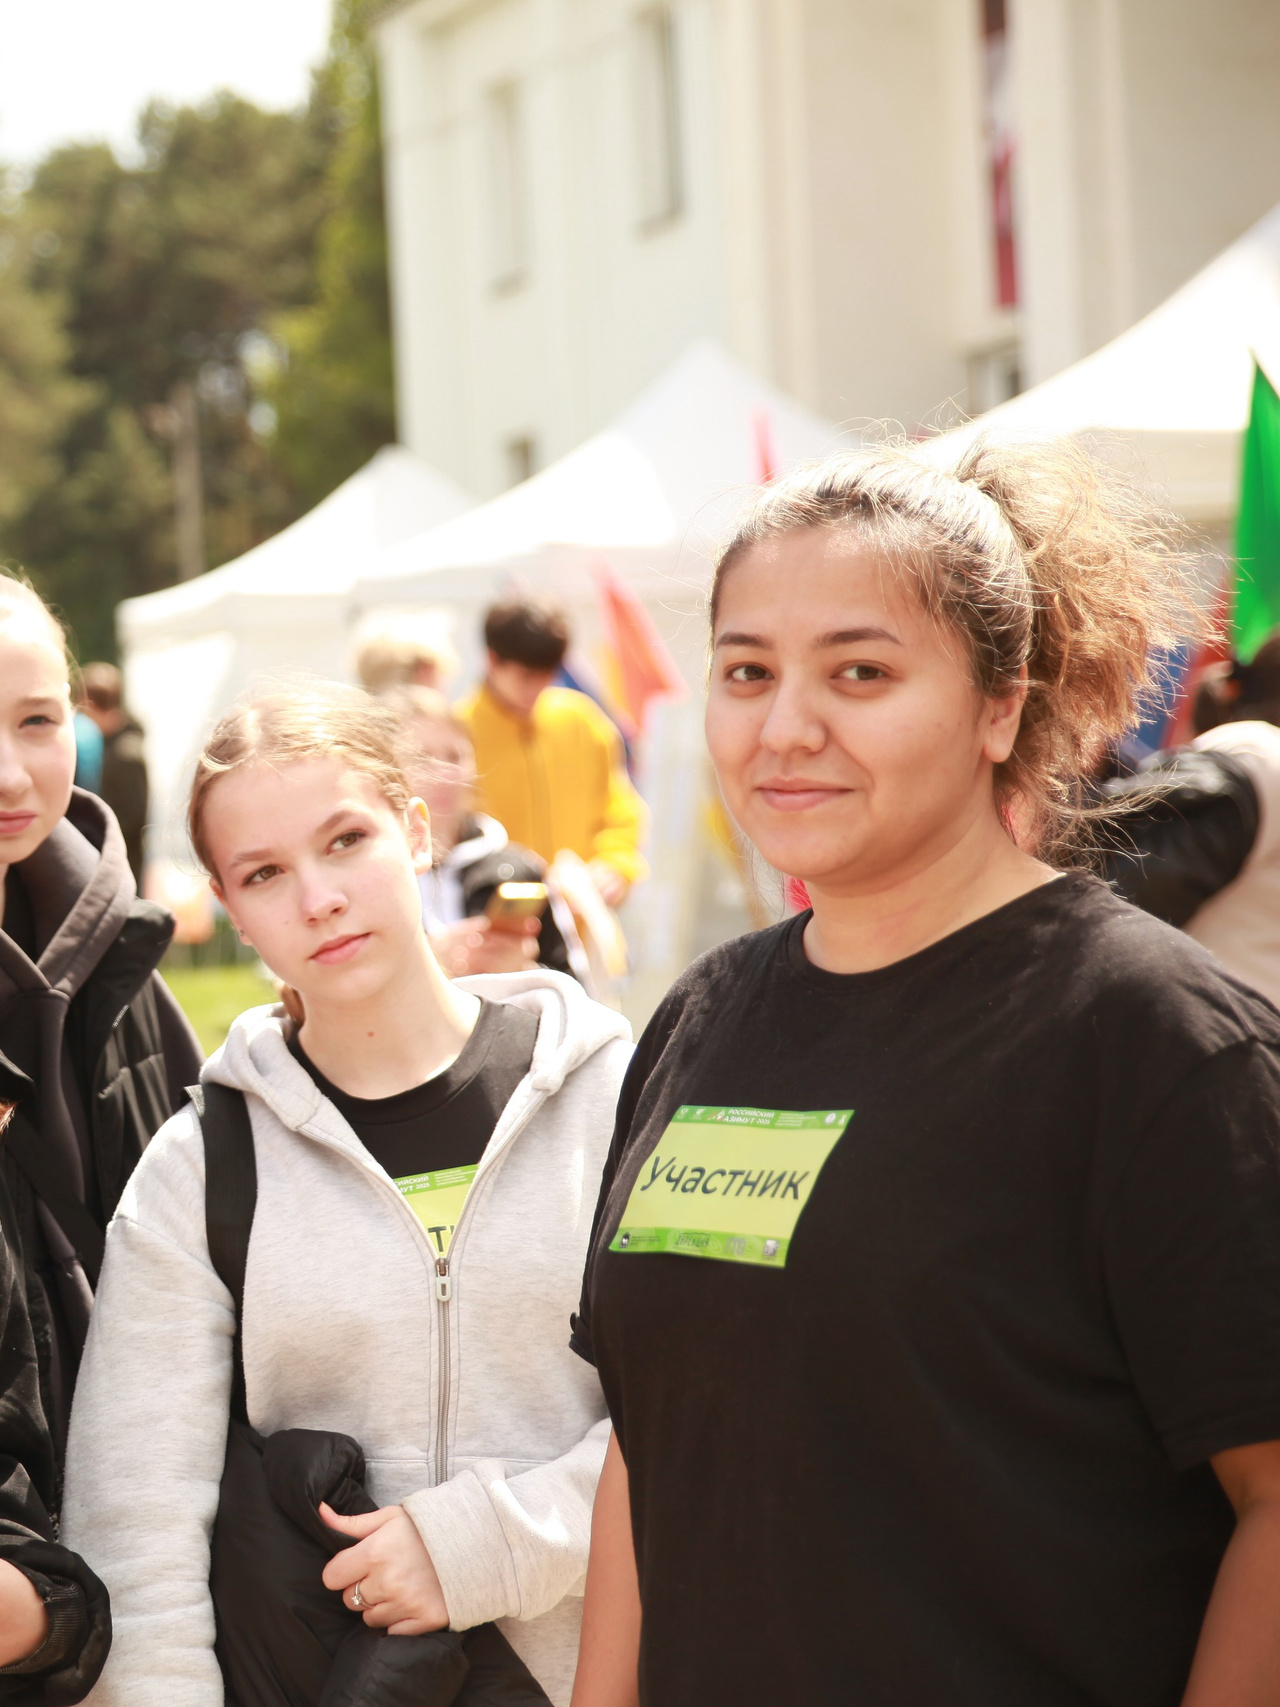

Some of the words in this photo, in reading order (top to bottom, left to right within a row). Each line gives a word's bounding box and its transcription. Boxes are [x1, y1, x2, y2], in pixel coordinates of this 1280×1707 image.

[728, 1108, 775, 1118] РОССИЙСКИЙ
[723, 1116, 755, 1124] АЗИМУТ
[640, 1156, 810, 1200] Участник
